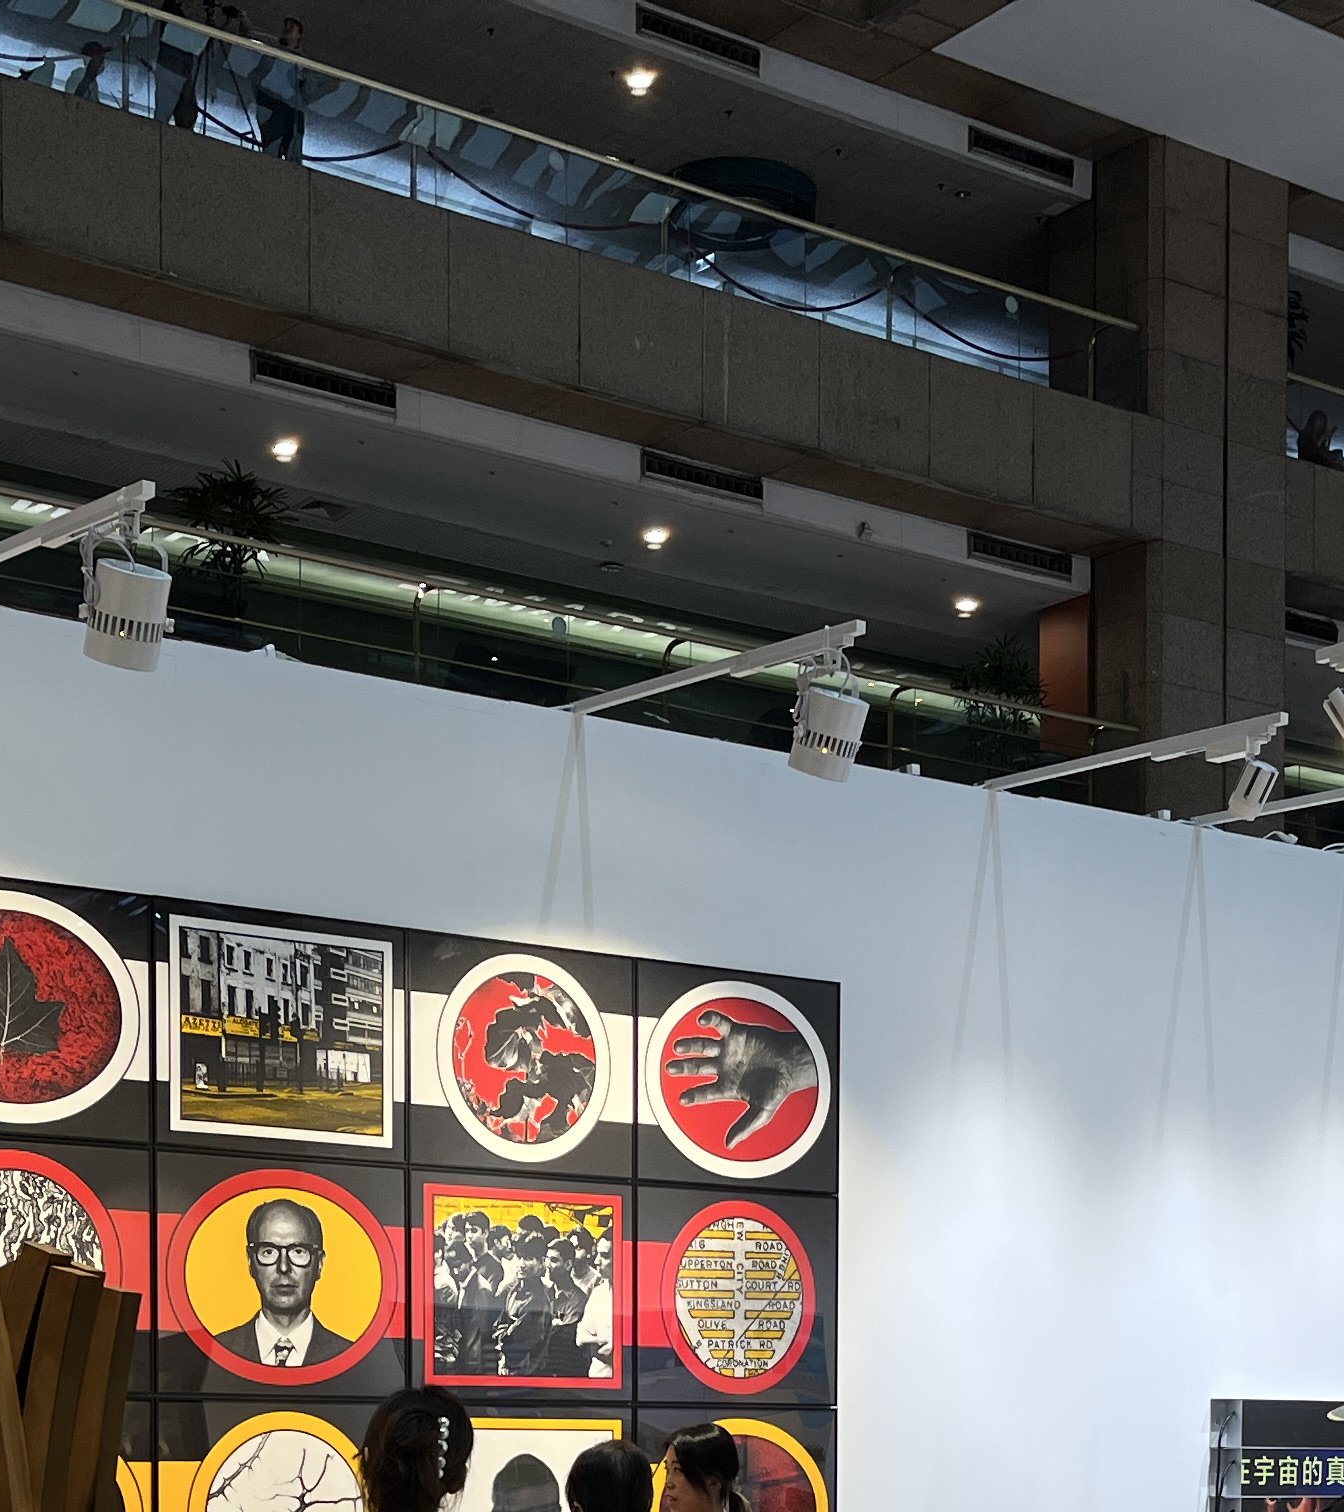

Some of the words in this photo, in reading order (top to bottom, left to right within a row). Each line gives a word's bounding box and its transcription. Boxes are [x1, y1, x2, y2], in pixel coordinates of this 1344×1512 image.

[755, 1241, 783, 1251] ROAD
[751, 1260, 777, 1269] ROAD
[745, 1281, 778, 1290] COURT
[687, 1299, 741, 1310] KINGSLAND
[768, 1301, 795, 1310] ROAD
[697, 1319, 727, 1330] OLIVE
[758, 1320, 786, 1330] ROAD
[707, 1339, 753, 1349] PATRICK
